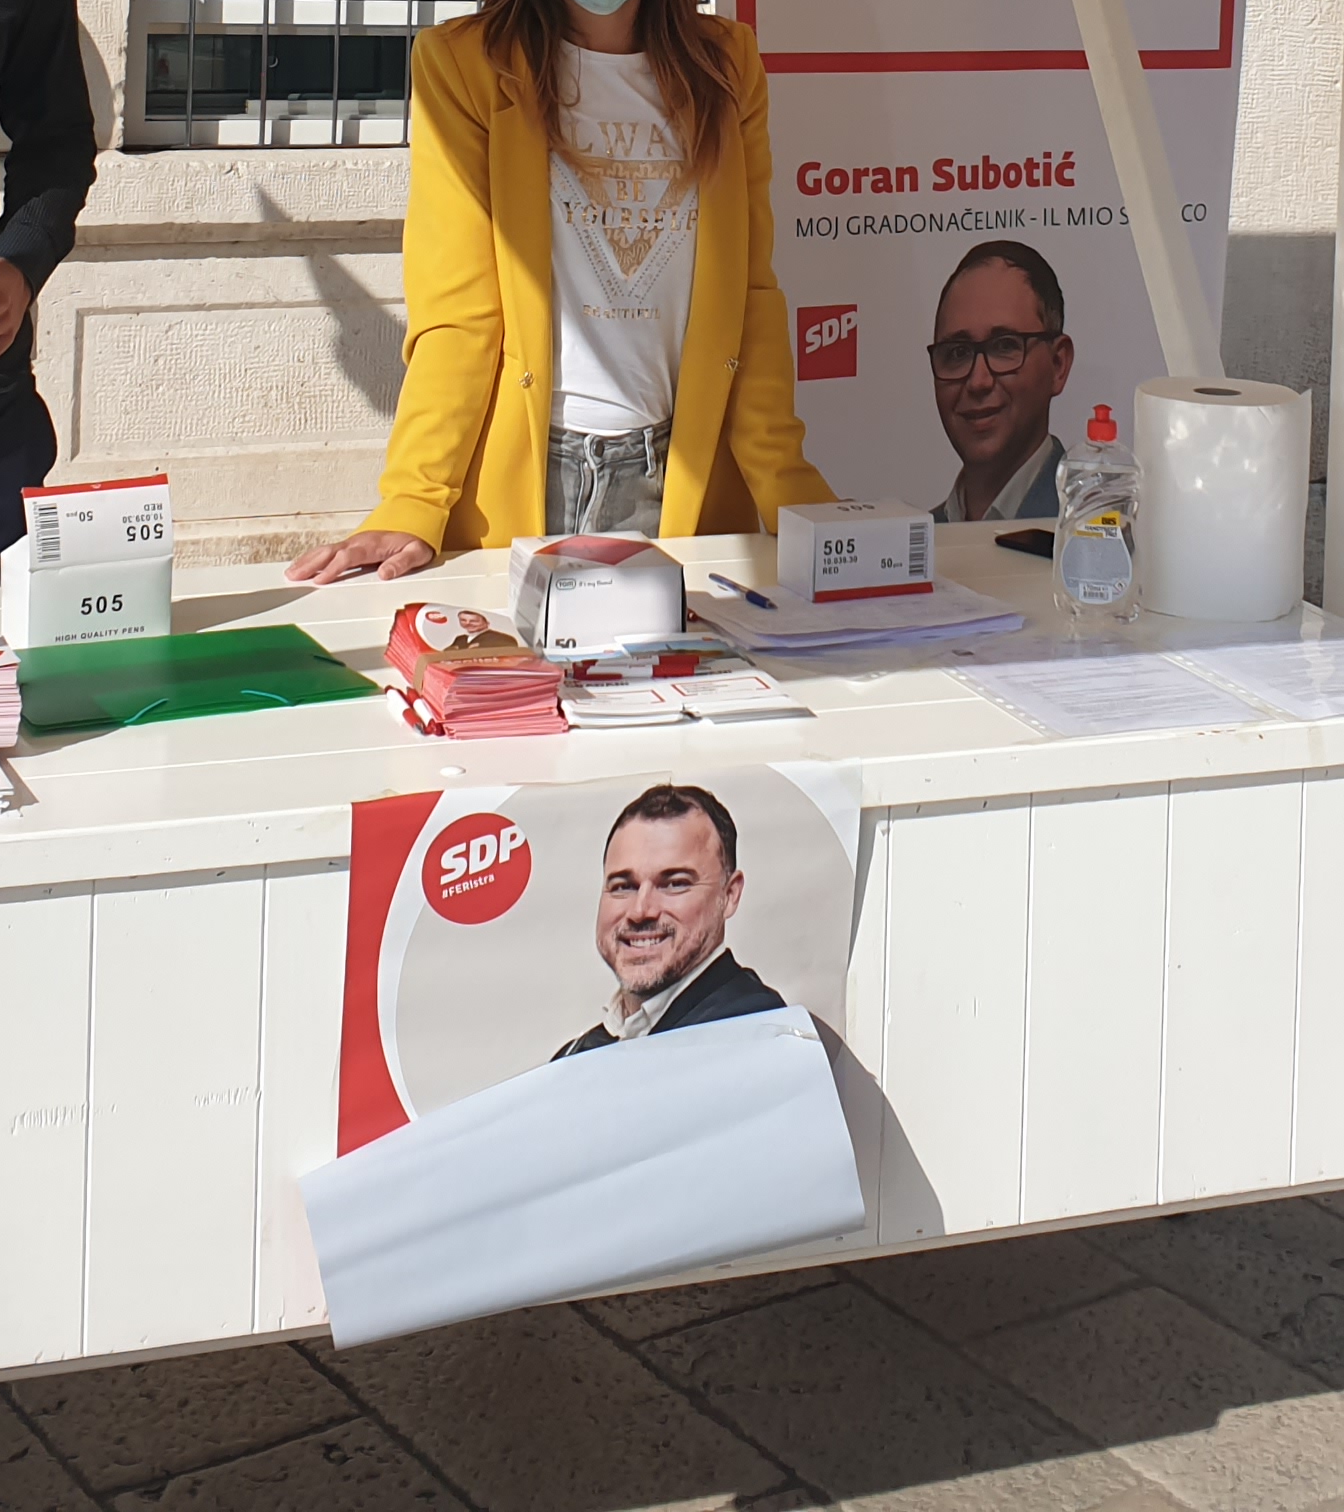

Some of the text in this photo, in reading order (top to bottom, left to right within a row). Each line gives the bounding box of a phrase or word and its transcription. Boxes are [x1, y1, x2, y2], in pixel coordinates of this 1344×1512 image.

[796, 151, 1076, 196] Goran Subotić
[616, 180, 646, 203] BE
[795, 215, 840, 240] MOJ
[846, 208, 1025, 236] GRADONAČELNIK
[1043, 209, 1061, 227] IL
[1066, 207, 1114, 226] MIO
[805, 311, 858, 354] SDP
[126, 523, 164, 542] 505
[823, 538, 856, 556] 505
[822, 567, 839, 575] RED
[80, 594, 124, 615] 505
[55, 625, 145, 642] HIGH QUALITY PENS
[440, 825, 526, 885] SDP
[442, 874, 495, 899] #FERIstra
